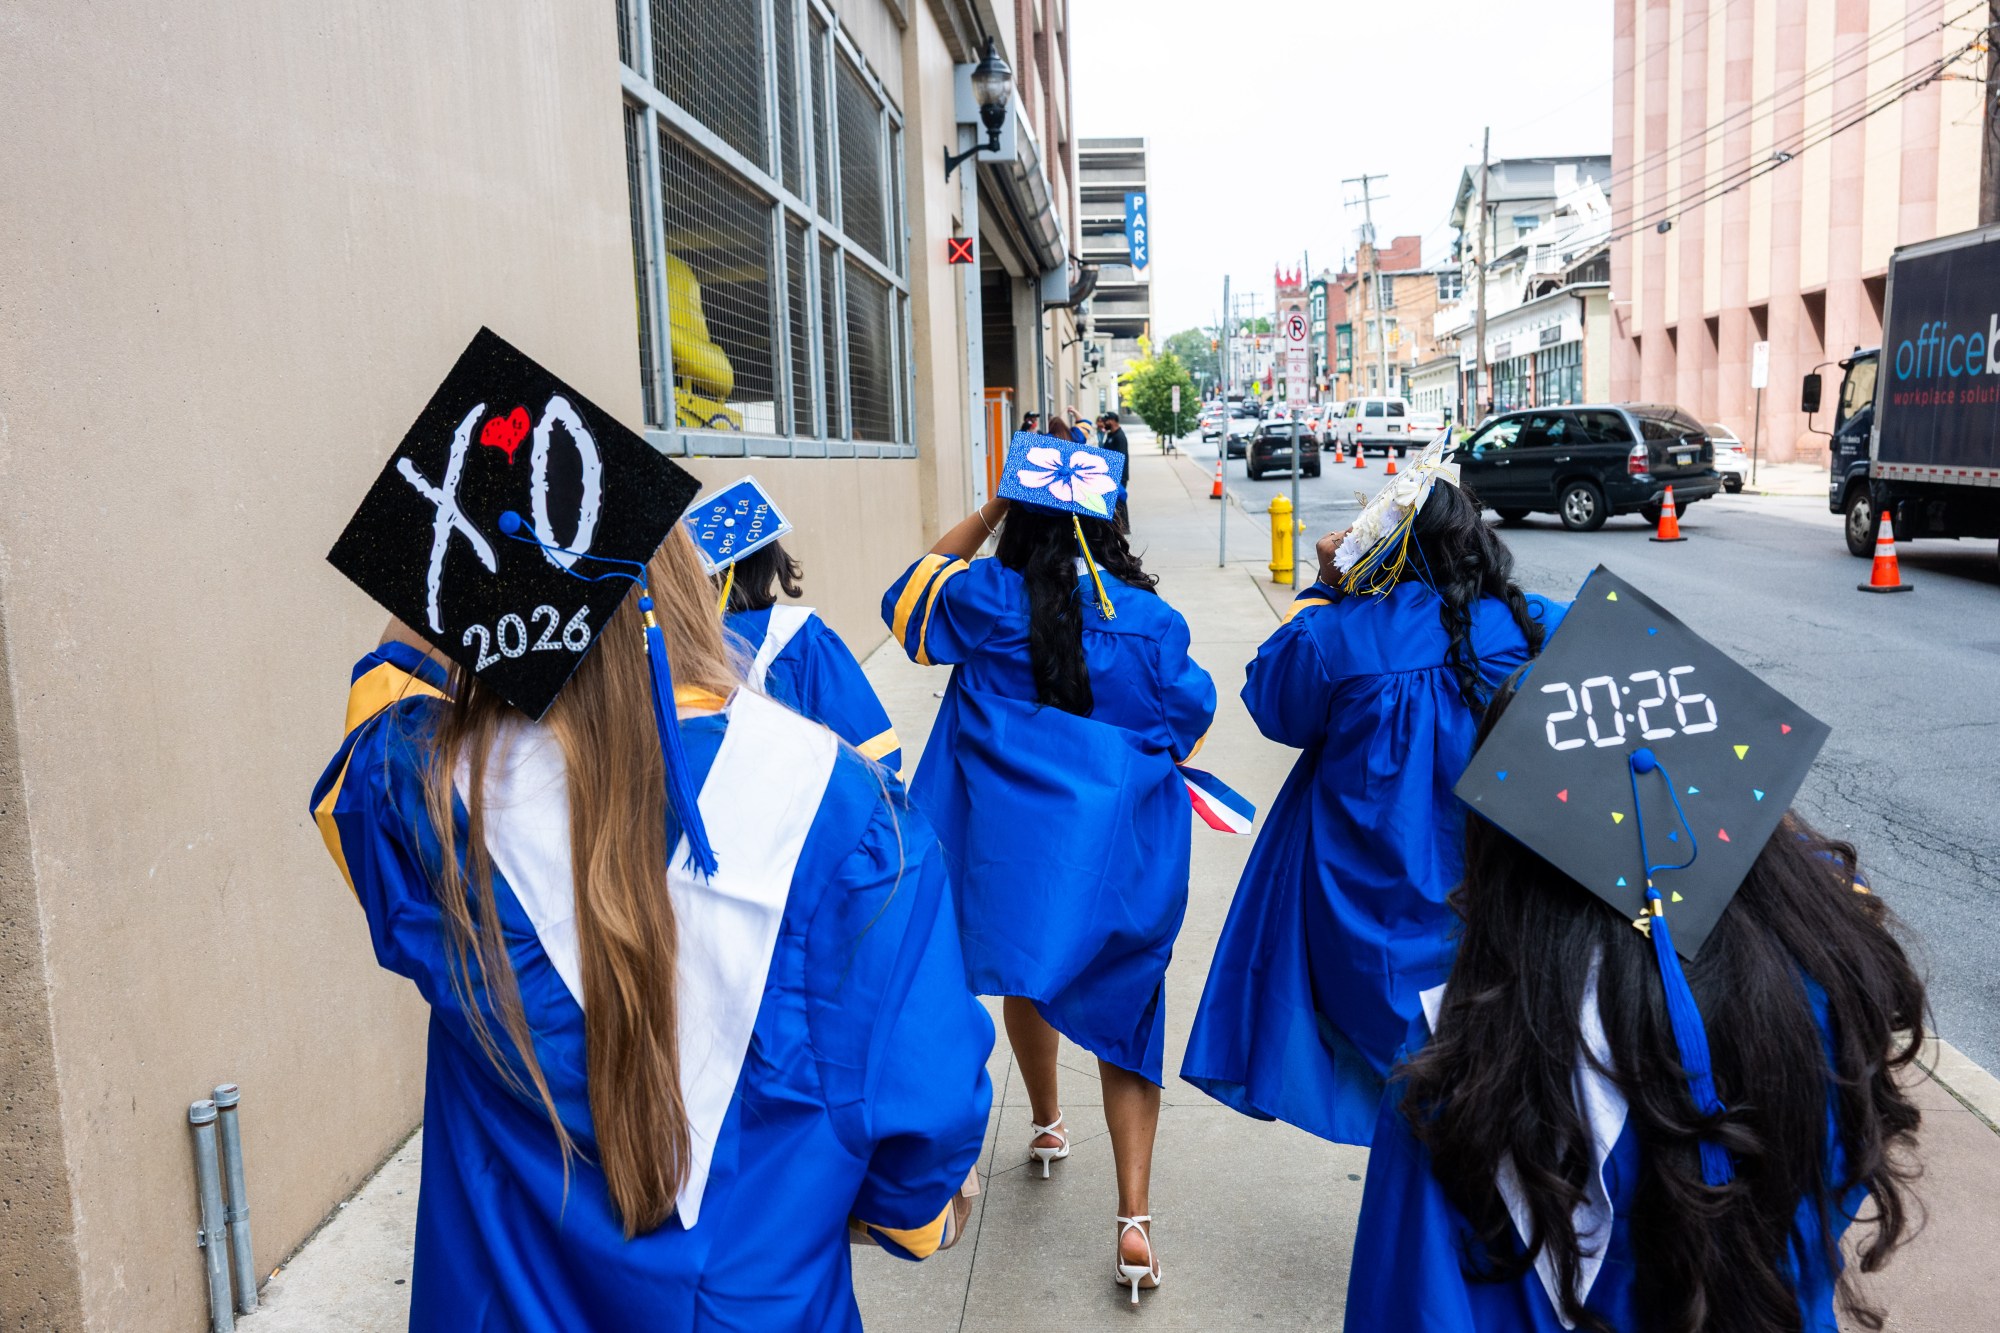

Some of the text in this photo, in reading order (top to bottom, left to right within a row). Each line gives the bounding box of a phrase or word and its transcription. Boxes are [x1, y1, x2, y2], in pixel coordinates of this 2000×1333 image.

[1132, 196, 1146, 260] PARK
[1894, 387, 1955, 407] workplace
[701, 506, 727, 540] Dios
[718, 499, 749, 554] Sea La
[746, 503, 769, 543] Gloria
[463, 605, 591, 672] 2026
[1540, 665, 1718, 750] 20:26
